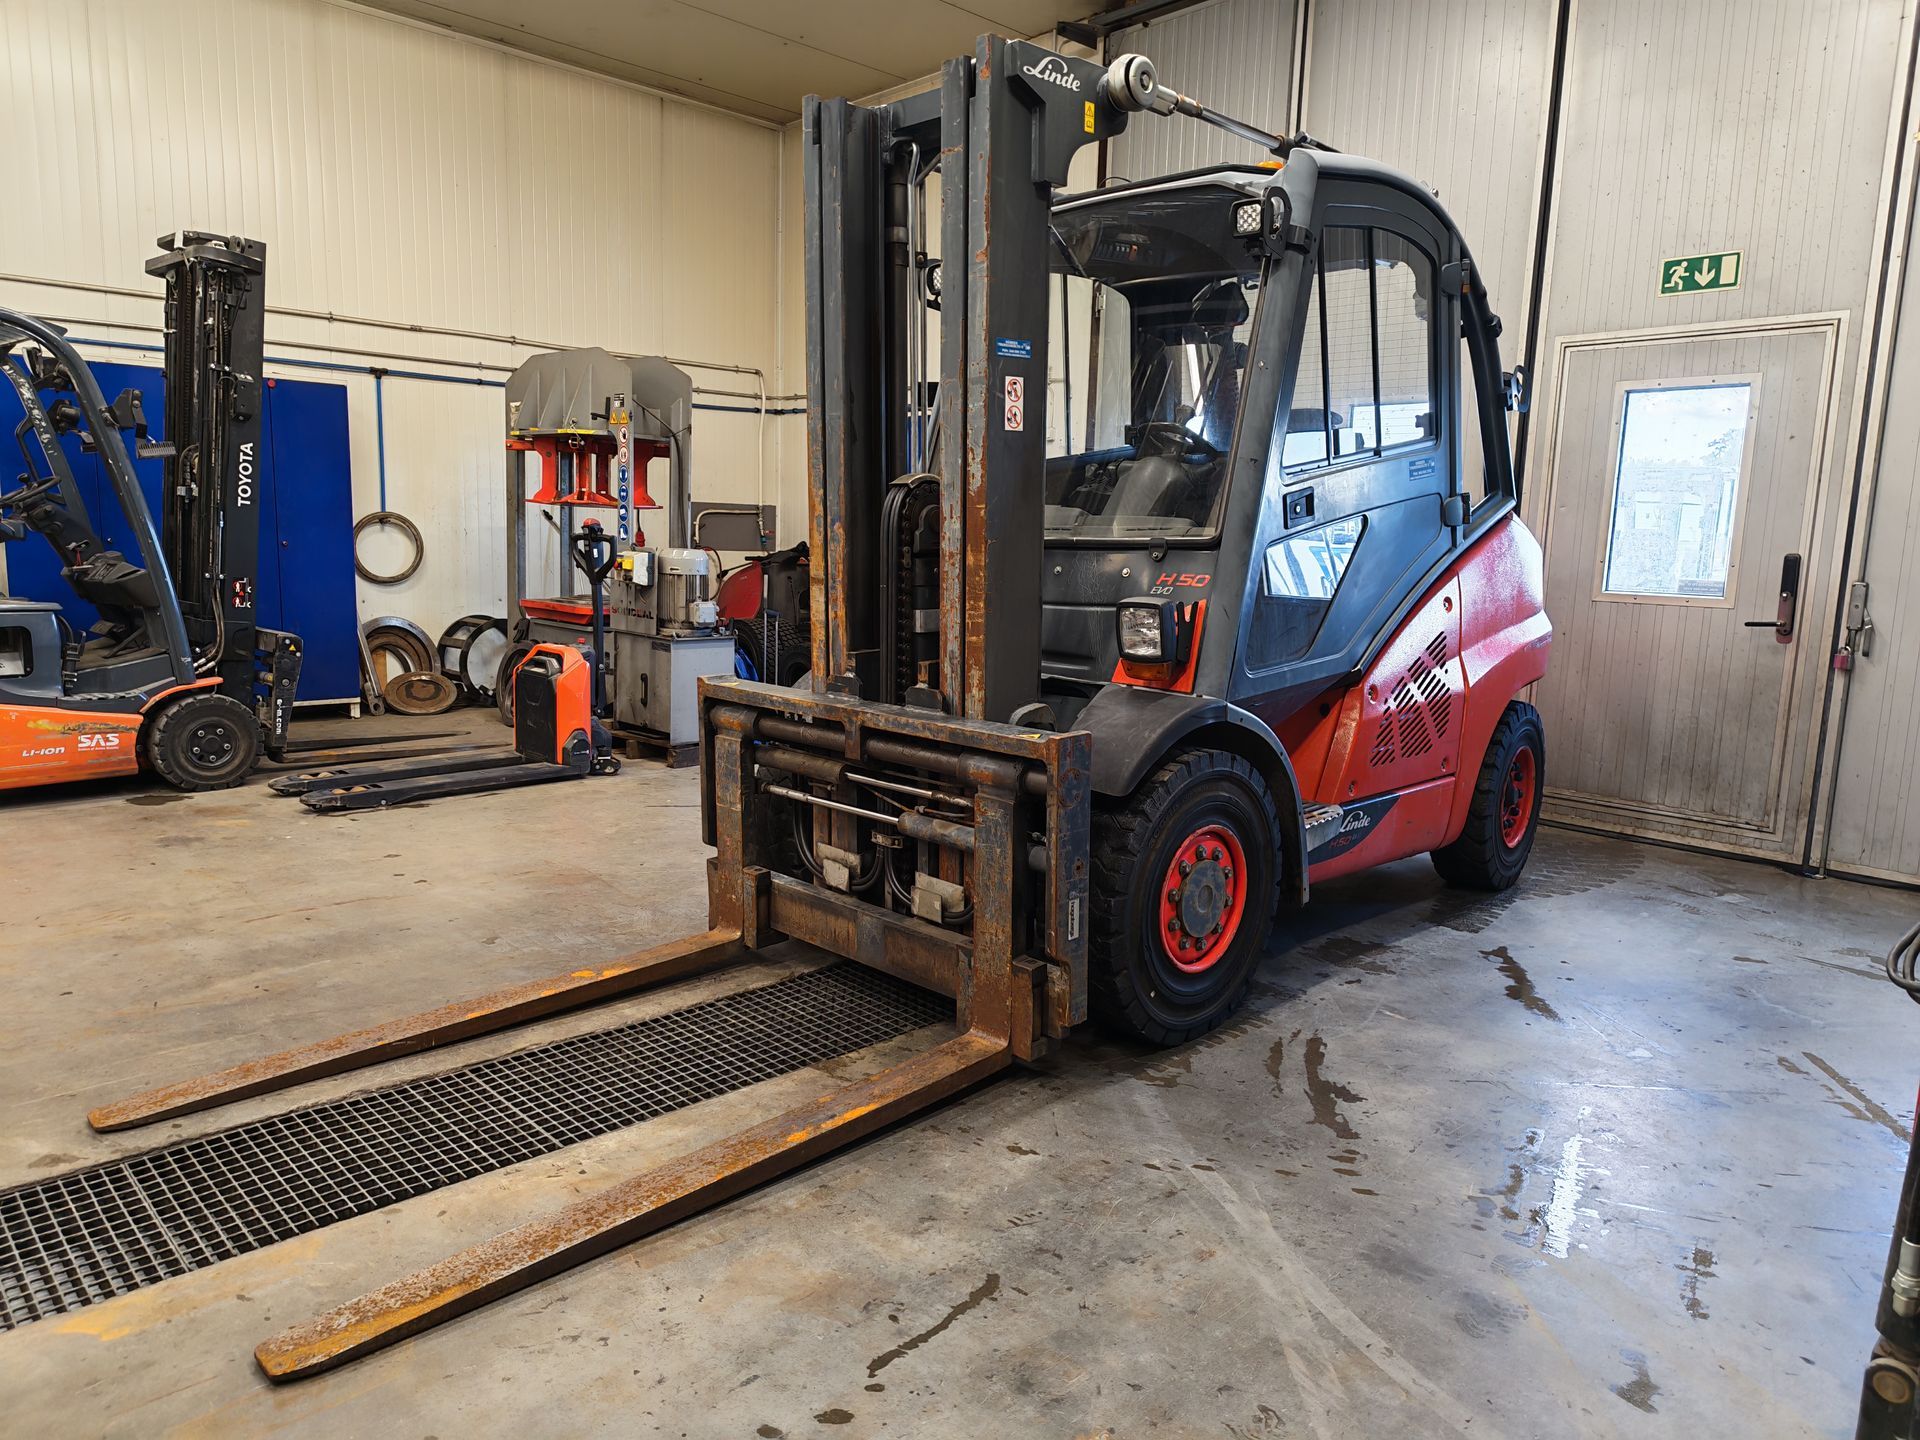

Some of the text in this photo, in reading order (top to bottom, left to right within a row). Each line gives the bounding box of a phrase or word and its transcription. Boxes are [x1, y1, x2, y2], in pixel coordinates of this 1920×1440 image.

[1022, 56, 1081, 92] Linde
[237, 442, 254, 507] TOYOTA
[1150, 586, 1174, 595] EVO
[77, 733, 120, 748] SAS
[1339, 810, 1371, 833] Linde
